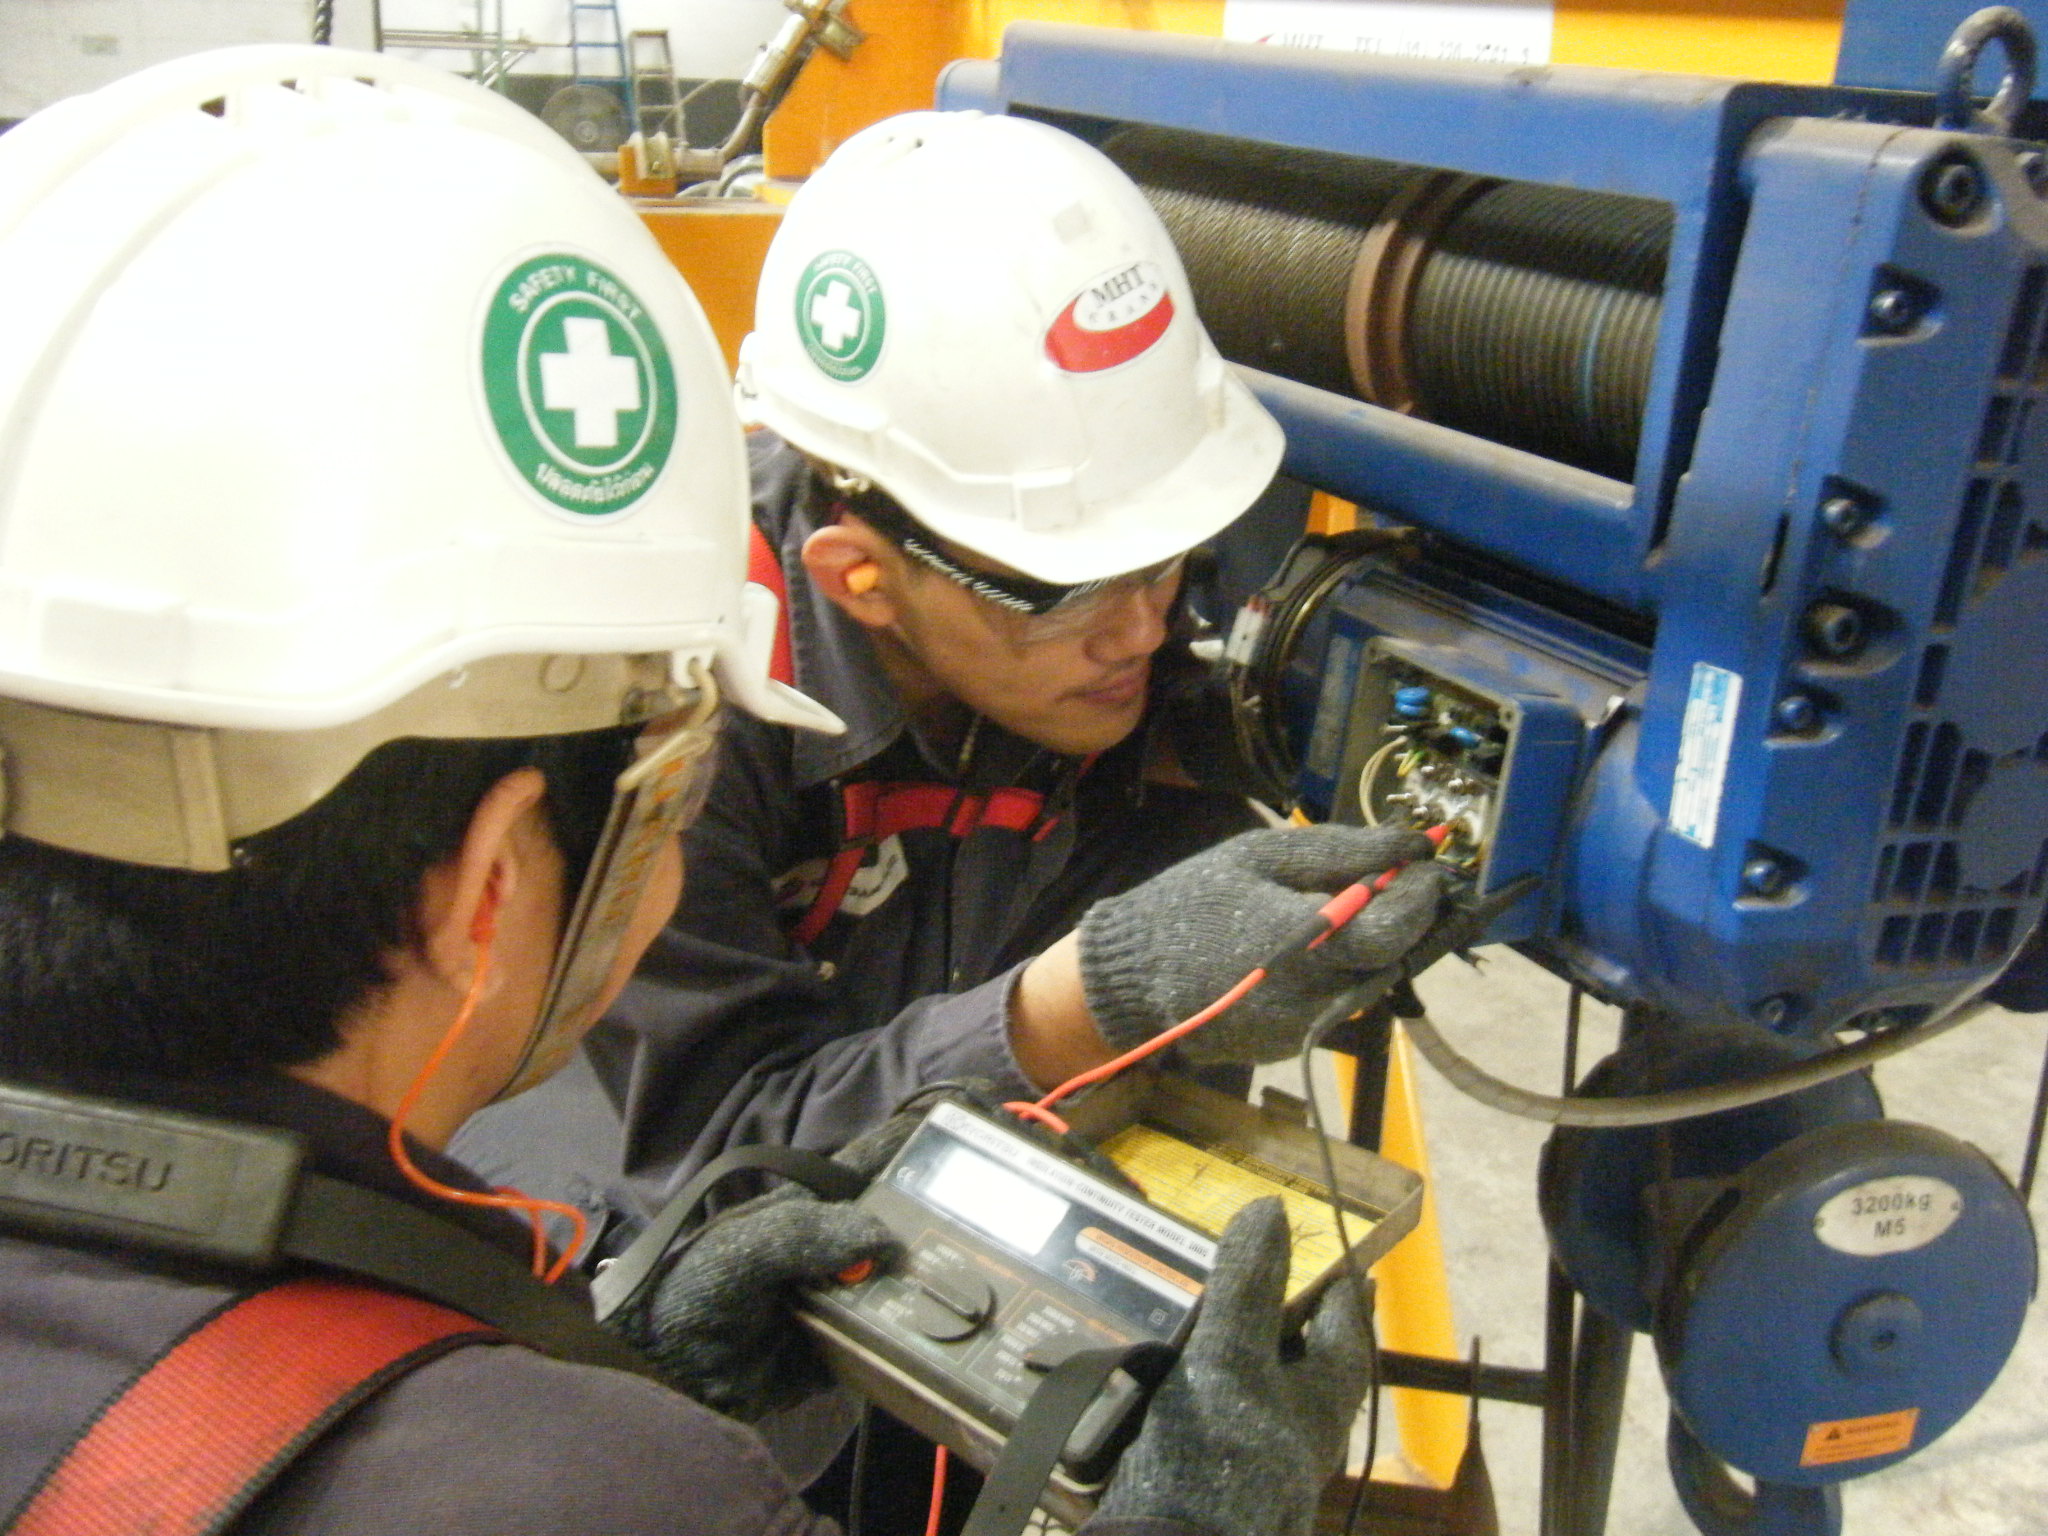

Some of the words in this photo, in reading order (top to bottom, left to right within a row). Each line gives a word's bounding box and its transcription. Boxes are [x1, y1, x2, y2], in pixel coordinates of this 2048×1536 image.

[508, 264, 577, 314] SAFETY
[586, 270, 643, 321] FIRST
[1091, 264, 1145, 308] MHT
[1851, 1190, 1933, 1217] 3200kg
[1874, 1217, 1906, 1240] M5
